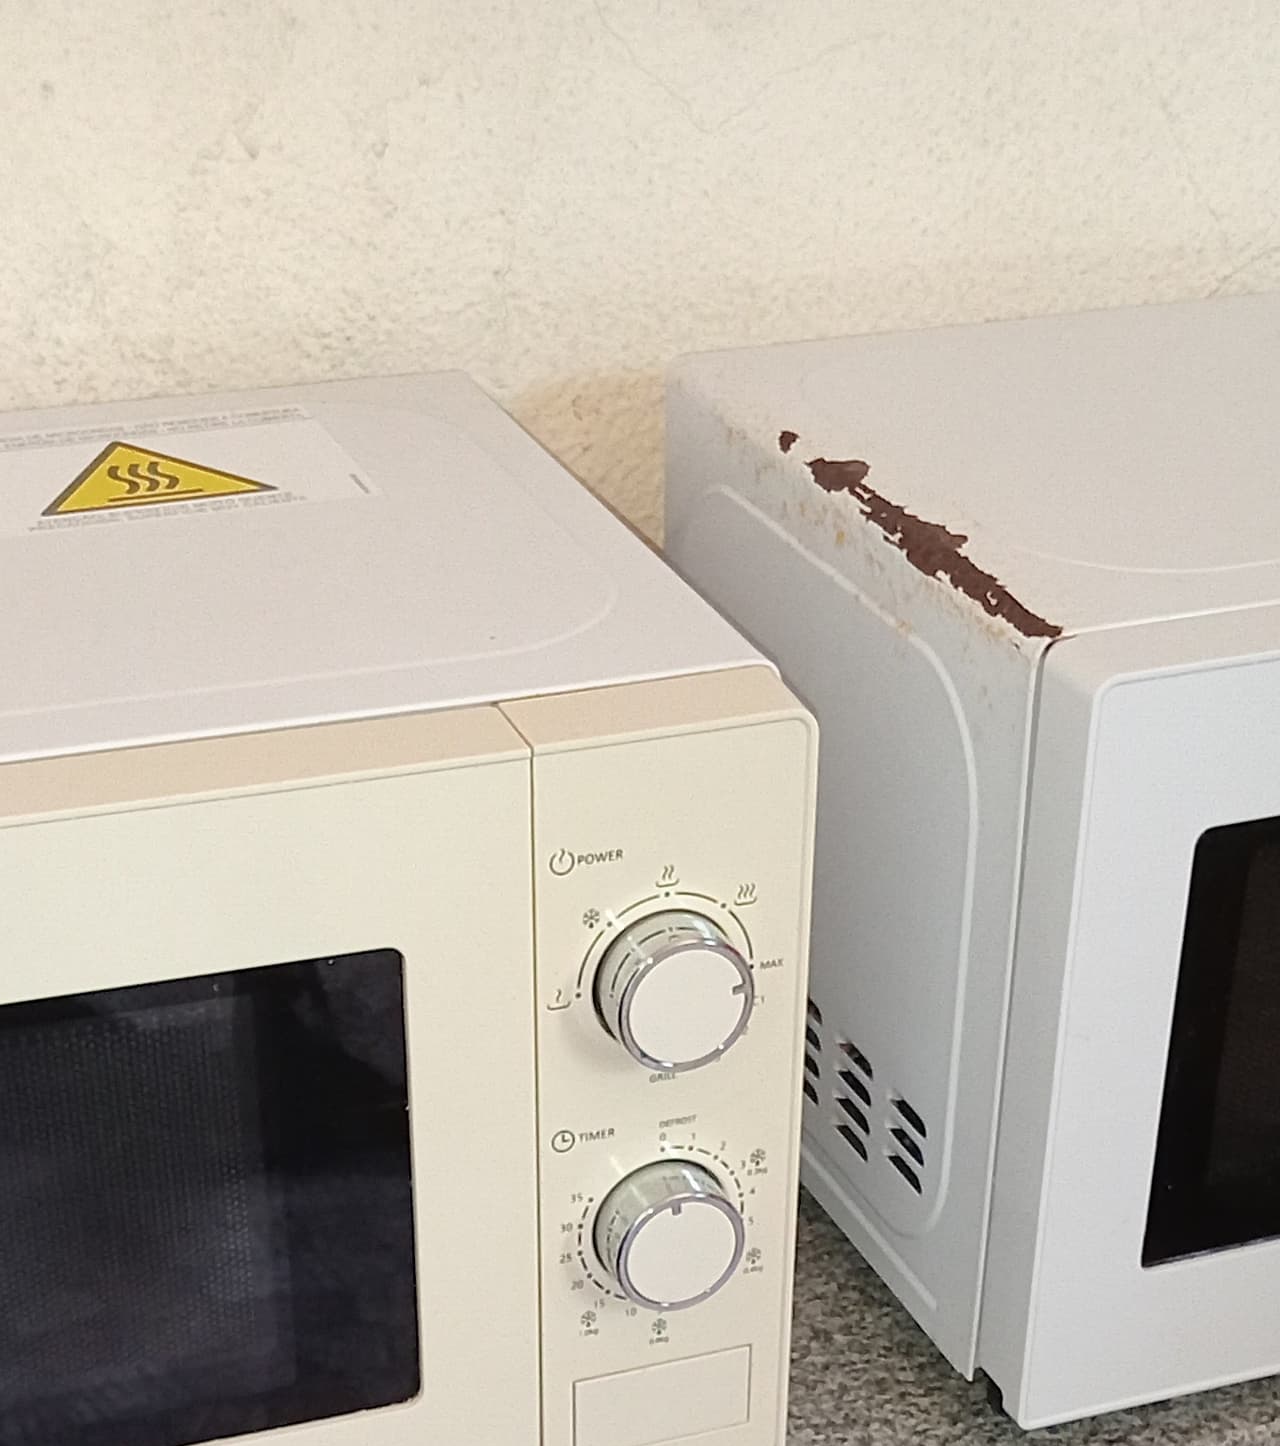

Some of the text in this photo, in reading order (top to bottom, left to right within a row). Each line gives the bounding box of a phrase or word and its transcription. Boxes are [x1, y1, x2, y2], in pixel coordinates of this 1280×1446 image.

[577, 849, 624, 866] POWER
[759, 959, 784, 970] MAX
[649, 1072, 677, 1084] GRILL
[578, 1127, 616, 1145] TIMER
[659, 1132, 667, 1142] 0
[570, 1193, 584, 1203] 35
[560, 1222, 573, 1233] 30
[559, 1254, 572, 1264] 25
[570, 1280, 585, 1291] 20
[594, 1299, 605, 1309] 15
[625, 1306, 638, 1317] 10
